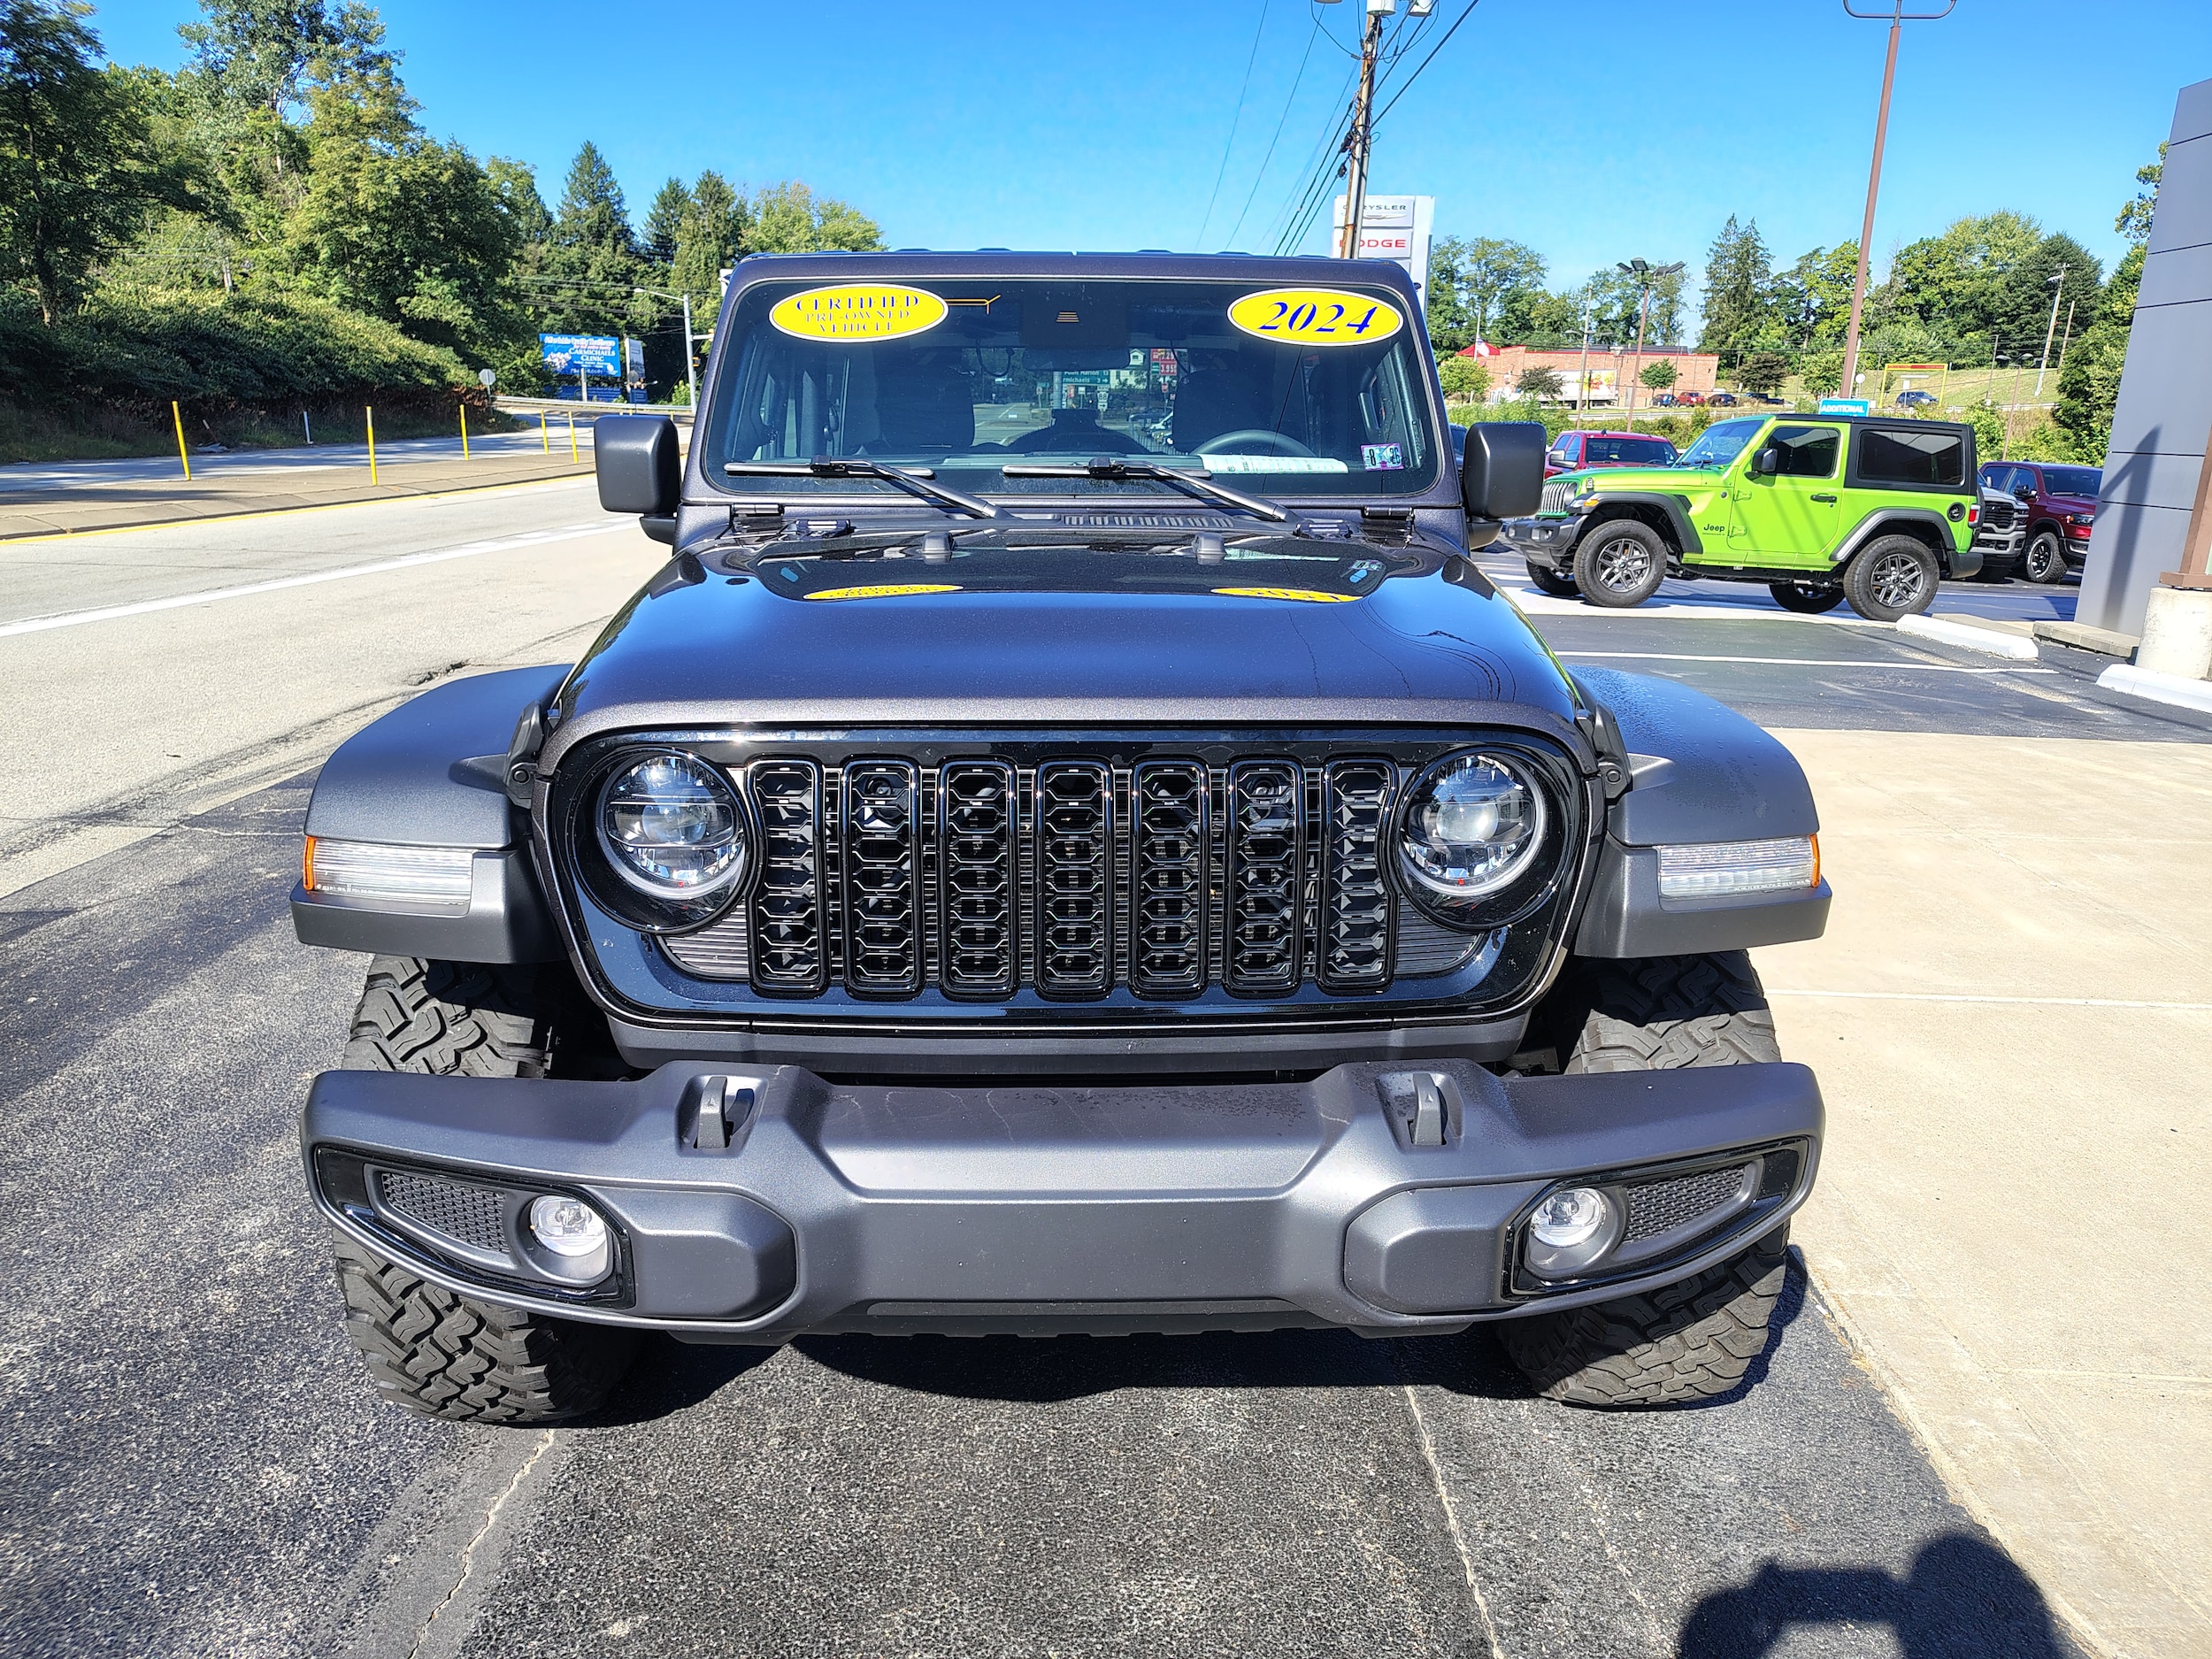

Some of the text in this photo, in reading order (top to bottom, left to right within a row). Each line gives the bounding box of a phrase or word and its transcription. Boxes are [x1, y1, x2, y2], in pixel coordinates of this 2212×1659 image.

[1340, 239, 1407, 248] DGE
[796, 296, 918, 311] CERTIFIED
[806, 310, 910, 322] PRE-OWNED
[1257, 302, 1379, 334] 2024
[819, 321, 895, 333] VEHICLE
[568, 348, 616, 357] CARMICHAELS
[1821, 404, 1865, 413] ADDITIONAL
[1369, 449, 1376, 465] 8
[1389, 447, 1400, 465] 26
[1703, 524, 1725, 533] Jeep
